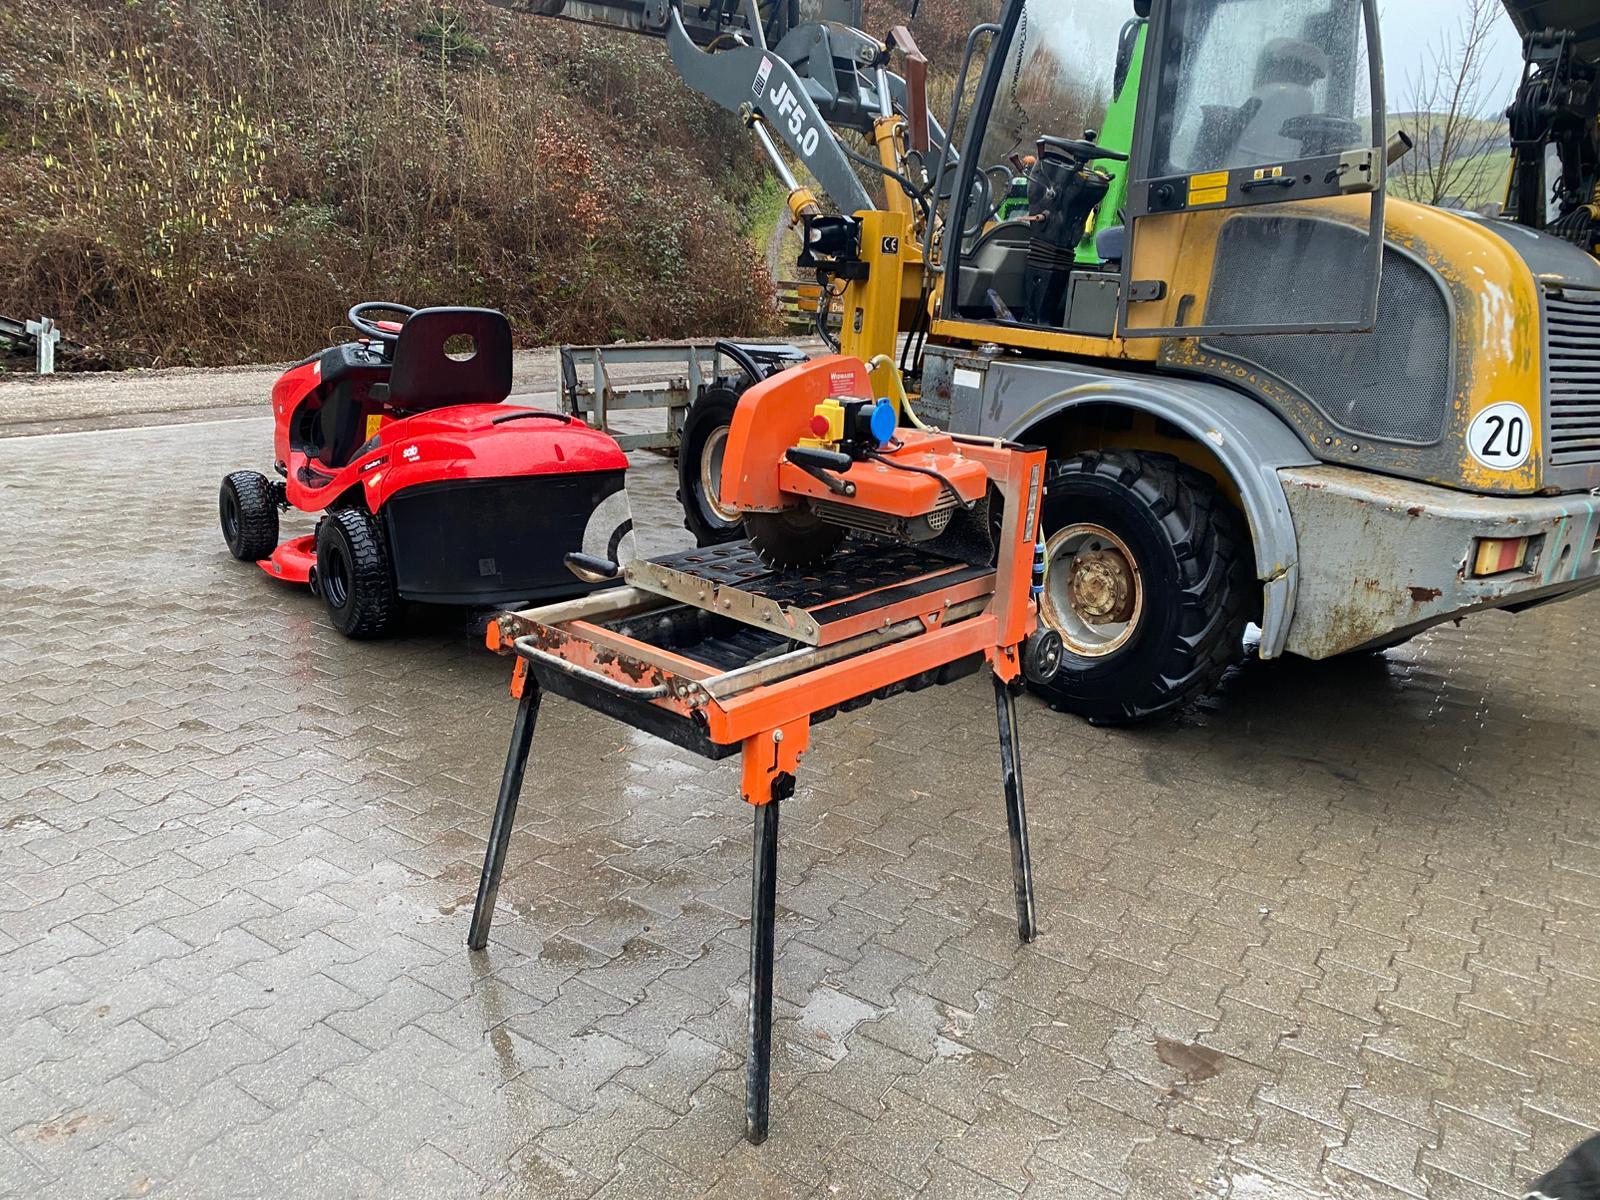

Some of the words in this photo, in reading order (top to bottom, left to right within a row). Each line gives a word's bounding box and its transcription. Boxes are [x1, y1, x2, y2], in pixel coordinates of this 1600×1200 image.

[769, 80, 820, 157] JF5.0
[883, 237, 897, 251] CE
[1481, 415, 1524, 457] 20
